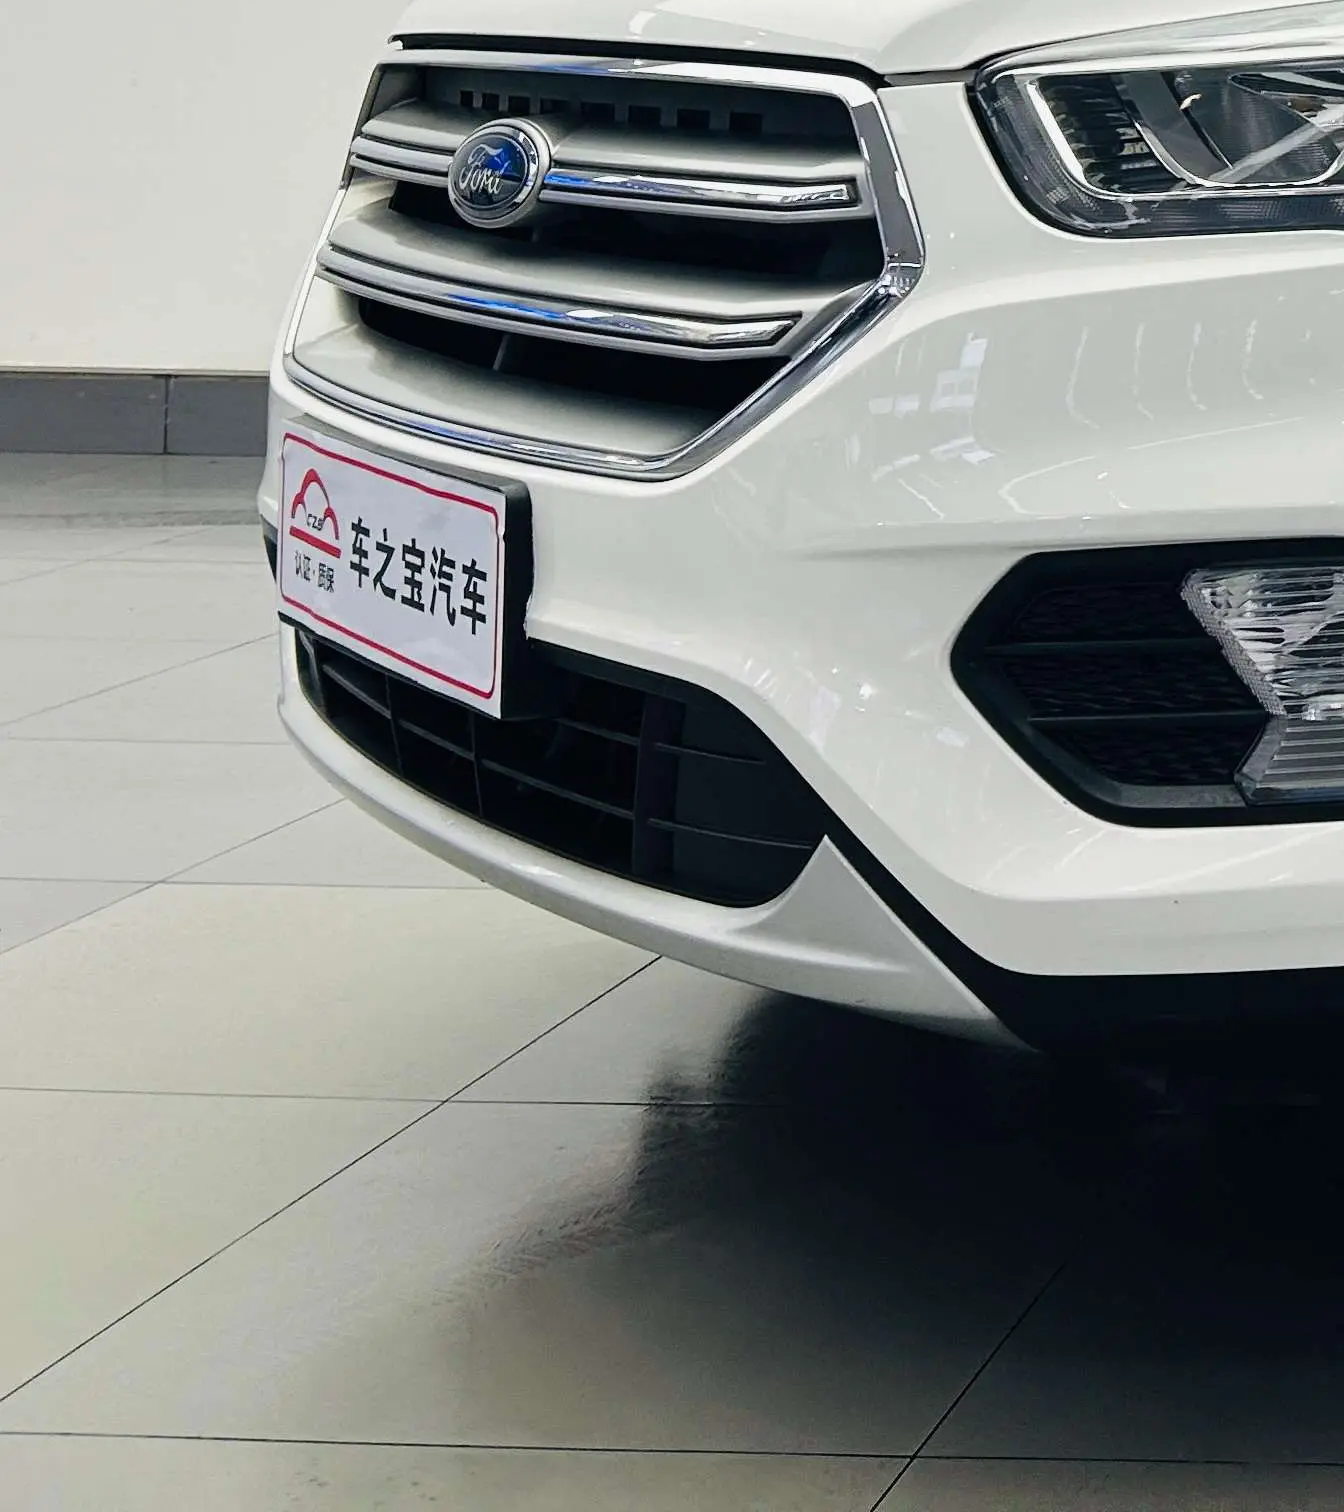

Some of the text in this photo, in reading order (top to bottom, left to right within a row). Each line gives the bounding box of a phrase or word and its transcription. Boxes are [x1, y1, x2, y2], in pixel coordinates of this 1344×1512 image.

[460, 144, 512, 194] Ford
[349, 516, 488, 635] 车之宝汽车
